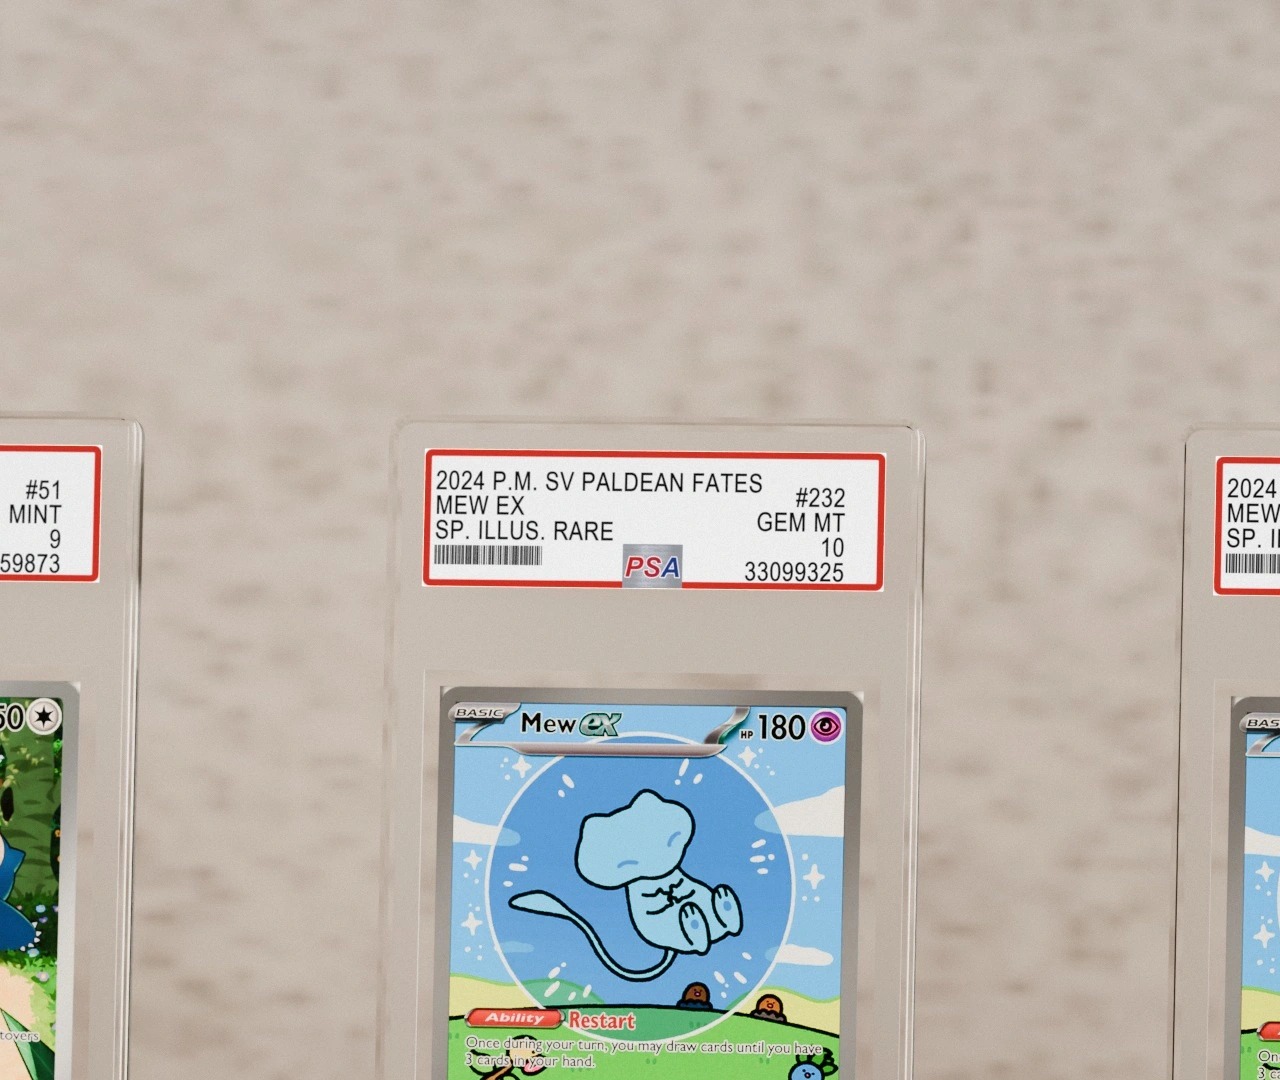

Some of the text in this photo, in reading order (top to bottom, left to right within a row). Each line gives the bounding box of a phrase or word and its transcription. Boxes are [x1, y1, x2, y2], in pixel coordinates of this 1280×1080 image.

[26, 480, 59, 499] #51
[437, 471, 762, 493] 2024 P.M. SV PALDEAN FATES
[1228, 478, 1276, 498] 2024
[437, 495, 524, 515] MEW EX
[796, 488, 844, 507] #232
[10, 505, 61, 523] MINT
[758, 512, 845, 532] GEM MT
[1228, 504, 1280, 523] MEW
[50, 529, 60, 548] 9
[436, 520, 613, 540] SP. ILLUS. RARE
[1227, 528, 1260, 547] SP.
[822, 538, 843, 557] 10
[624, 555, 681, 580] PSA
[745, 562, 843, 582] 33099325
[455, 707, 505, 719] BASIC
[521, 713, 578, 733] Mew
[740, 714, 807, 741] HP 180
[484, 1012, 545, 1025] Ability
[569, 1011, 636, 1030] Restart
[465, 1036, 823, 1059] Once during your turn, you may draw cards until you have
[465, 1053, 596, 1070] 3 cards in your hand.
